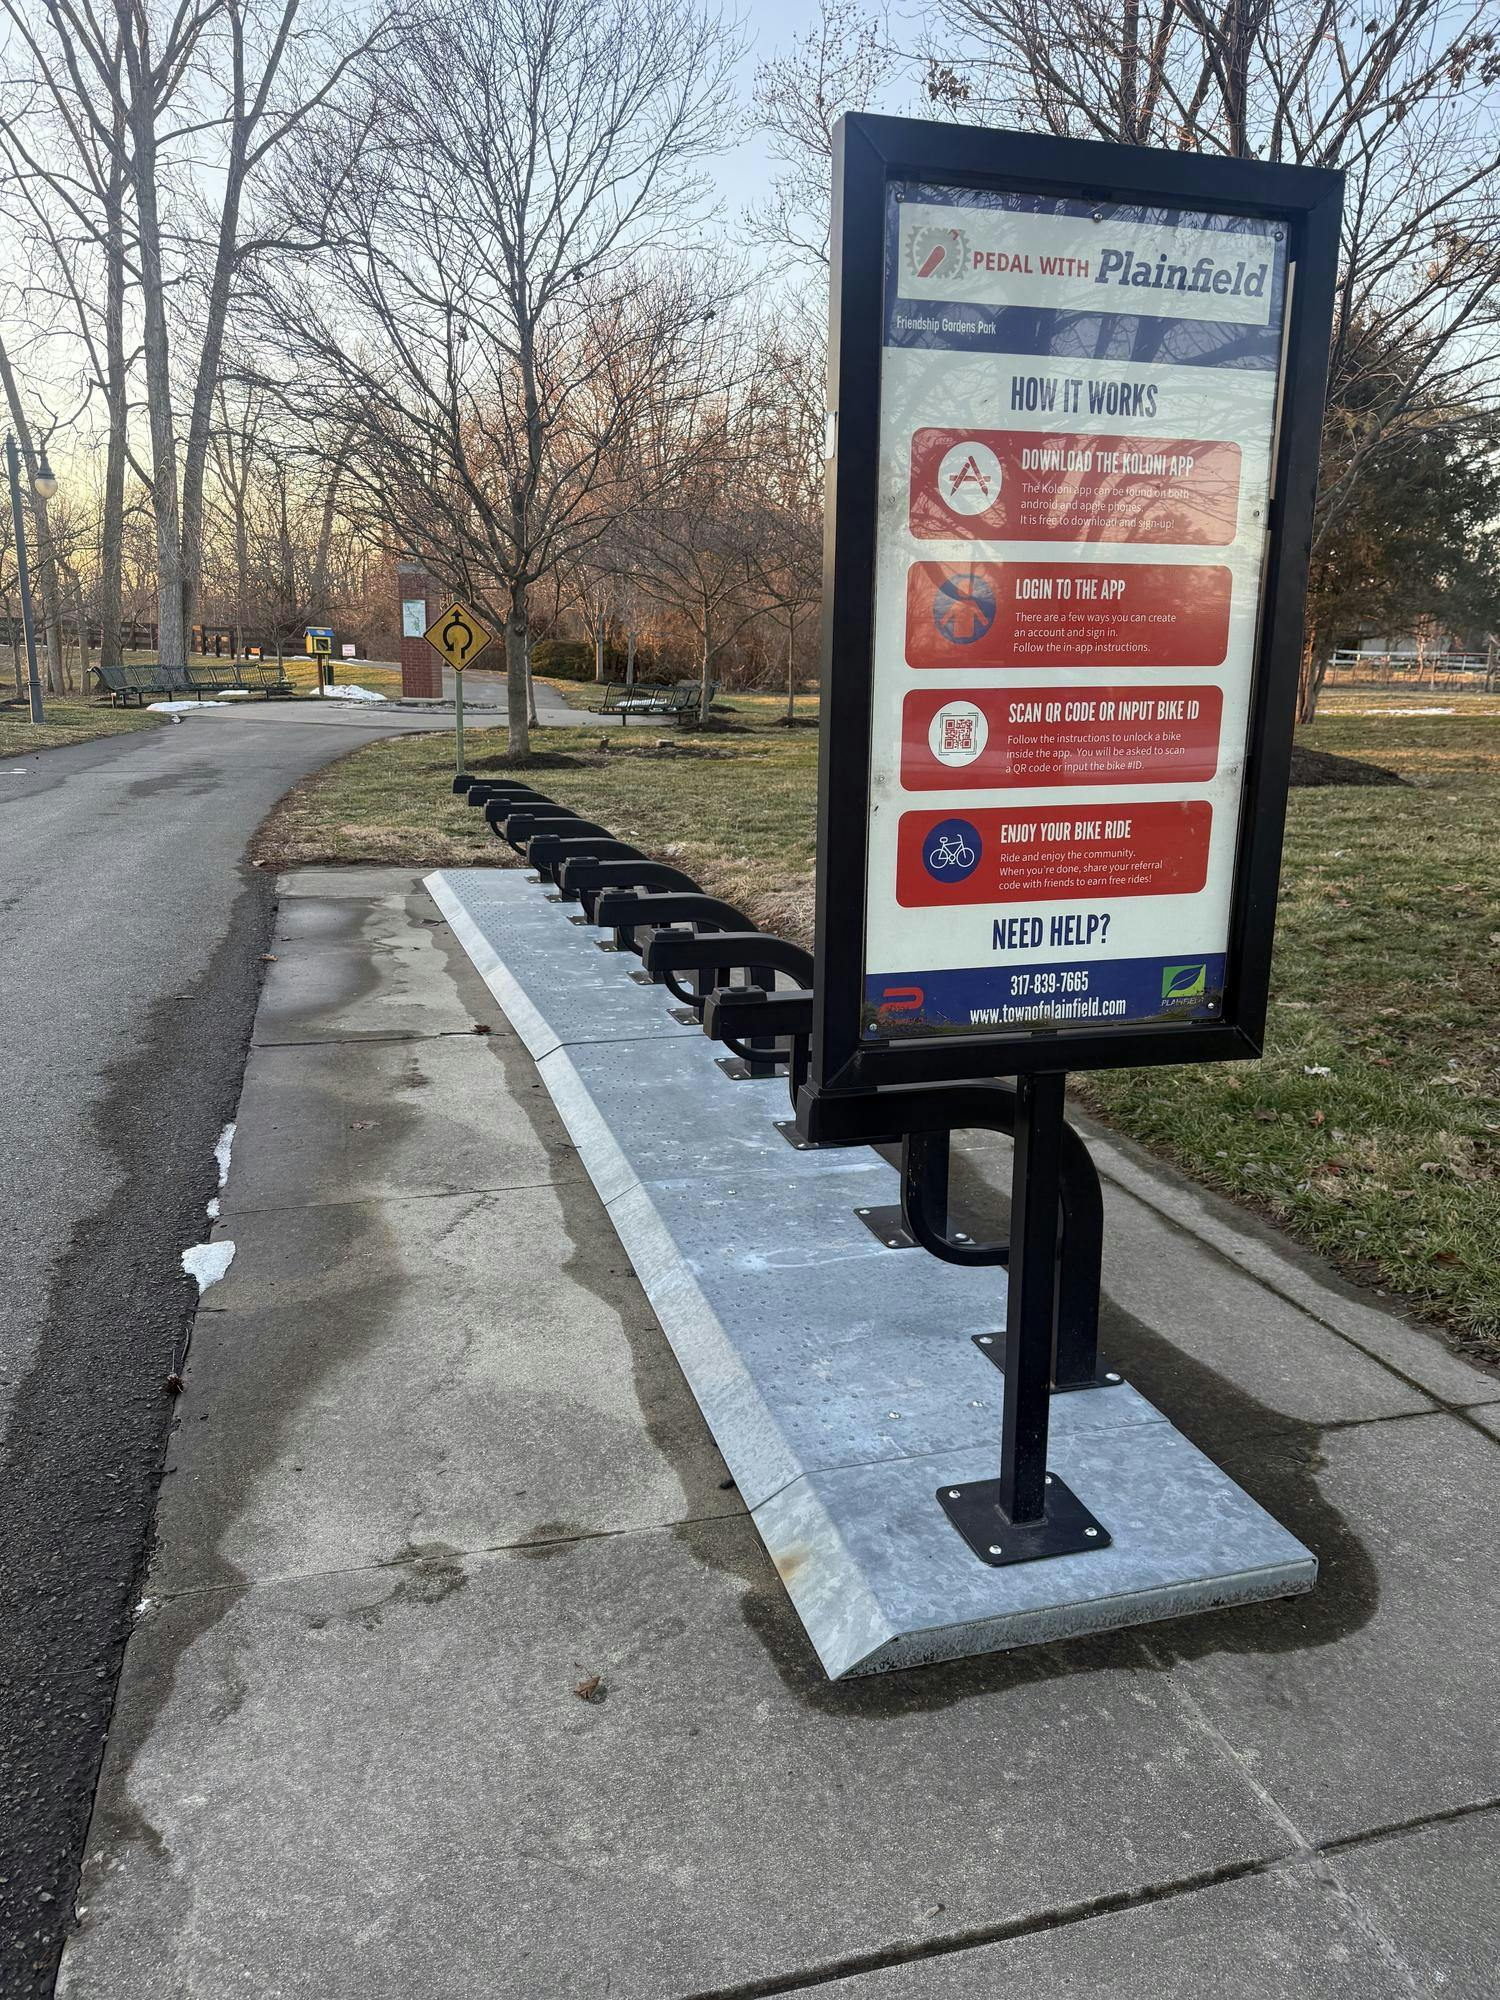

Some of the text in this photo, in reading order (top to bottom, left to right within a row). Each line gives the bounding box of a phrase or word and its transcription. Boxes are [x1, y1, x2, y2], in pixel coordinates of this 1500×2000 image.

[973, 248, 1268, 297] PEDAL WITH Plainfield
[896, 315, 997, 334] Friendship Gardens Park
[1011, 376, 1158, 417] HOW IT WORKS
[1022, 448, 1194, 476] DOWNLOAD THE KOLONI APP
[1022, 482, 1190, 499] The Koloni app can be found on both
[1020, 498, 1144, 514] android and apple phones.
[1020, 514, 1175, 531] It is free to download and sign-up!
[1015, 578, 1126, 600] LOGIN TO THE APP
[1015, 612, 1042, 622] There
[1043, 614, 1058, 622] are
[1068, 611, 1085, 622] few
[1087, 614, 1110, 624] ways
[1111, 614, 1128, 624] you
[1130, 614, 1147, 623] can
[1148, 613, 1177, 623] create
[1014, 626, 1118, 639] an account and sign in.
[1013, 642, 1151, 654] Follow the in-app instructions.
[1008, 700, 1200, 723] SCAN QR CODE OR INPUT BIKE ID
[1007, 731, 1181, 744] Follow the instructions to unlock a bike
[1006, 745, 1185, 760] inside the app. You will be asked to scan
[1005, 761, 1144, 775] a QR code or input the bike #ID.
[1000, 819, 1132, 843] ENJOY YOUR BIKE RIDE
[1000, 848, 1136, 863] Ride and enjoy the community.
[999, 859, 1163, 877] When you're done, share your referral
[999, 874, 1152, 890] code with friends to earn free rides!
[992, 913, 1111, 950] NEED HELP?
[1010, 971, 1089, 996] 317-839-7665
[969, 997, 1126, 1025] www.townofplainfield.com
